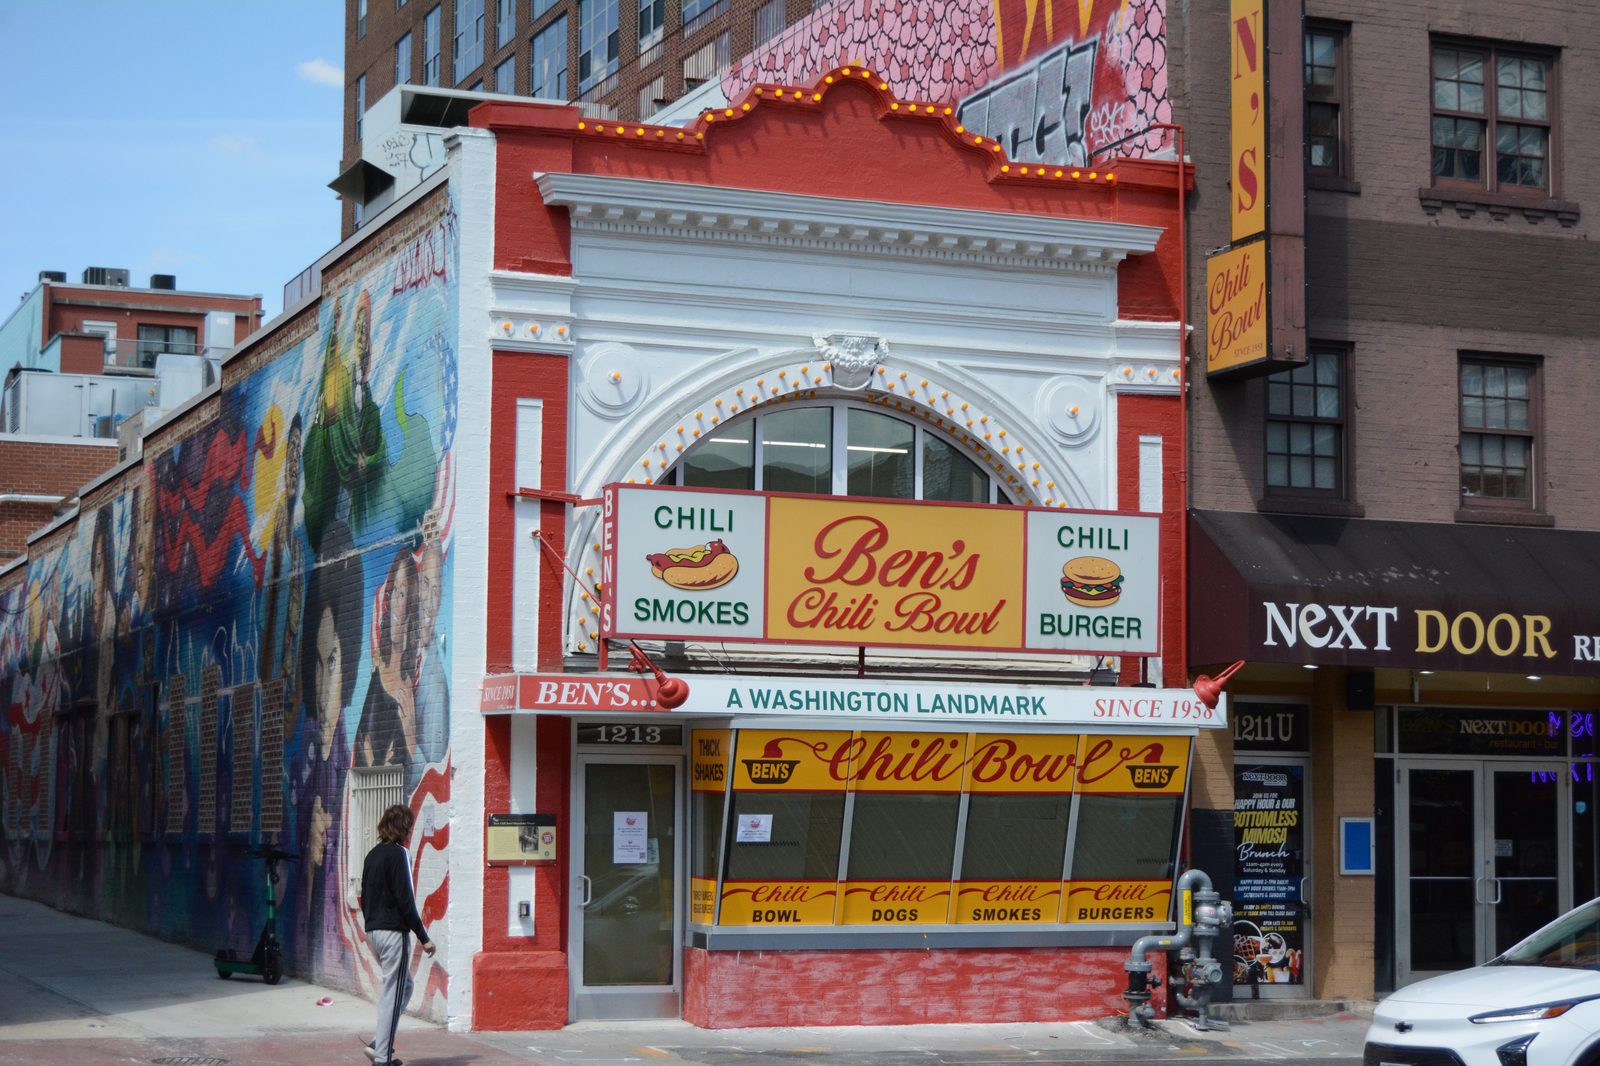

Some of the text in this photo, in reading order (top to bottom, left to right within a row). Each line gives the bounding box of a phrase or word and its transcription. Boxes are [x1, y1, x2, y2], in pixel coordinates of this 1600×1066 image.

[1209, 252, 1250, 316] Chili
[1209, 281, 1264, 362] Bowl
[1233, 344, 1251, 358] SINCE
[653, 505, 735, 532] CHILI
[1057, 526, 1129, 551] CHILI
[804, 515, 981, 591] Ben's
[633, 598, 750, 625] SMOKES
[786, 586, 877, 632] Chili
[885, 591, 1006, 635] Bowl
[1039, 612, 1143, 640] BURGER
[1414, 609, 1558, 659] DOOR
[484, 686, 501, 703] SINCE
[726, 687, 1047, 716] A WASHINGTON LANDMARK
[1093, 699, 1163, 719] SINCE
[597, 725, 662, 744] 1213
[1233, 713, 1295, 742] 1211 U
[698, 738, 721, 757] THICK
[822, 737, 1118, 785] Chili Bowl
[695, 763, 724, 782] SHAKES
[751, 762, 790, 780] BEN'S
[1134, 767, 1169, 786] BEN'S
[1235, 798, 1296, 810] HAPPY HOUR & OUR
[1233, 811, 1298, 827] BOTTOMLESS
[1241, 828, 1288, 844] MIMOSA
[1236, 841, 1290, 861] Brunch
[742, 884, 820, 903] Chili
[861, 885, 937, 903] Chili
[974, 885, 1049, 902] Chili
[1084, 884, 1158, 901] Chili
[752, 909, 802, 924] BOWL
[871, 908, 919, 922] DOGS
[972, 908, 1041, 922] SMOKES
[1078, 906, 1155, 921] BURGERS
